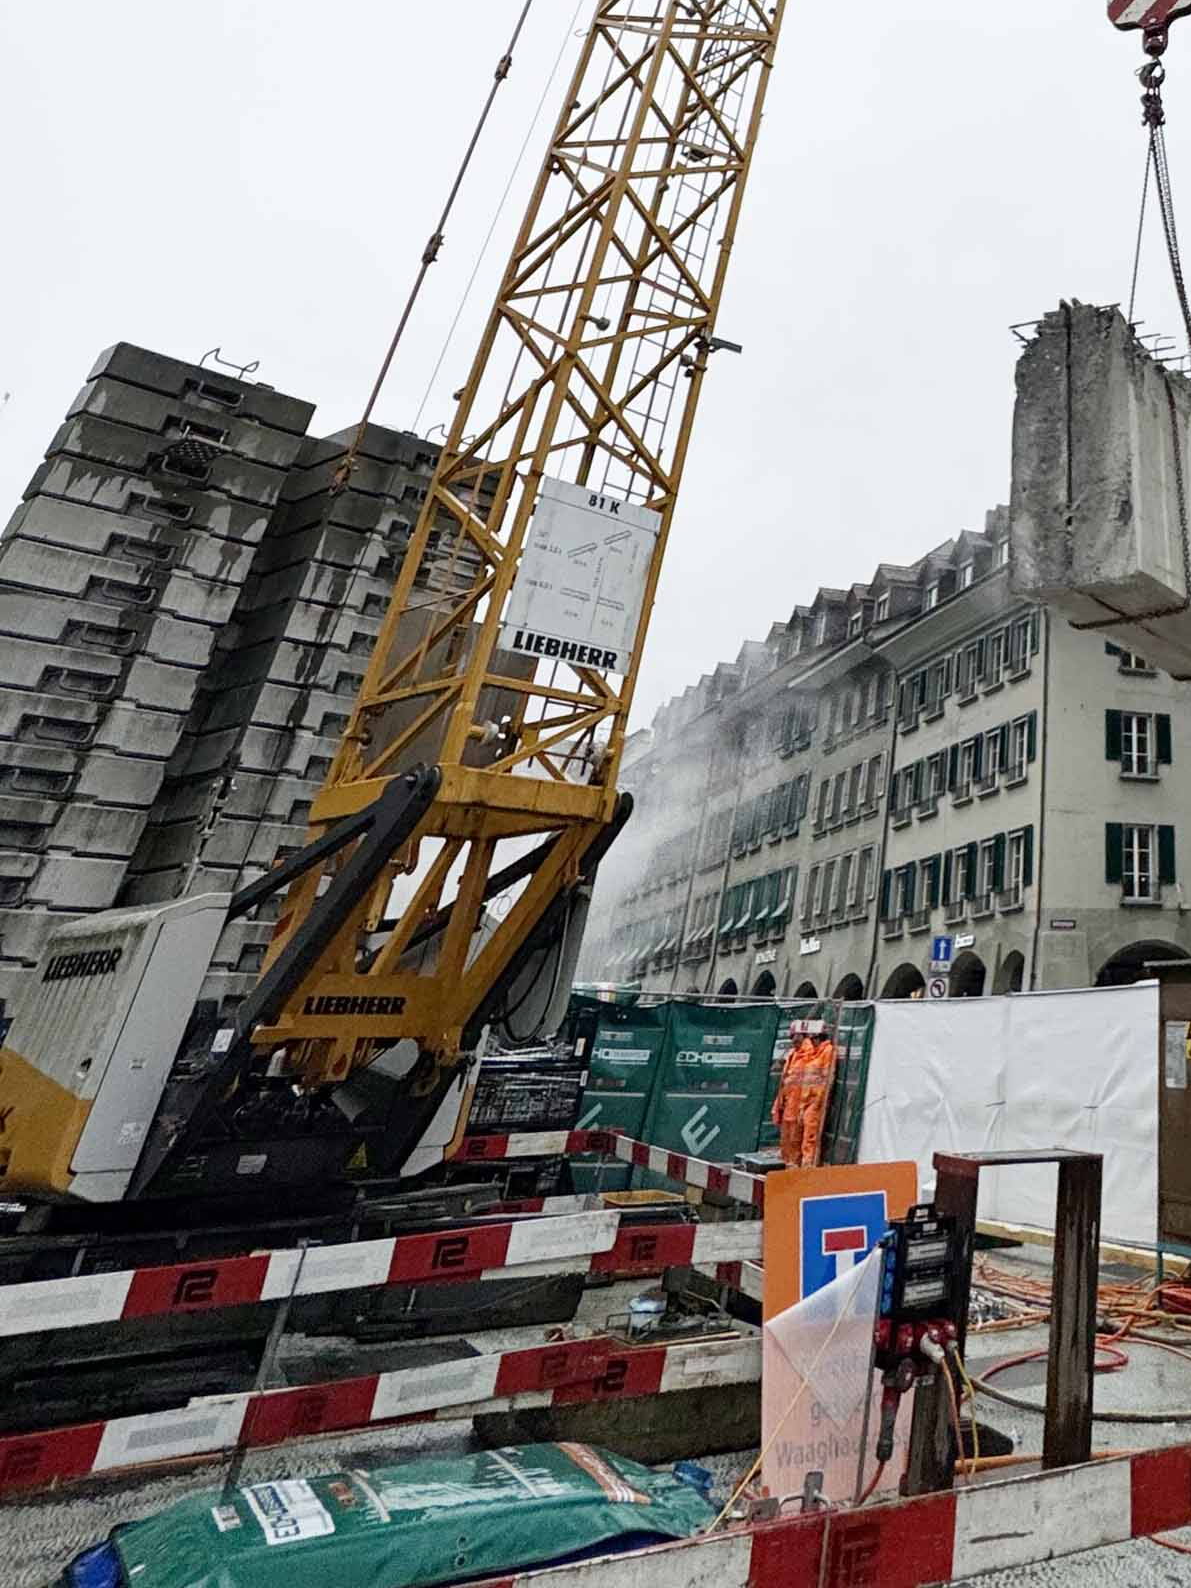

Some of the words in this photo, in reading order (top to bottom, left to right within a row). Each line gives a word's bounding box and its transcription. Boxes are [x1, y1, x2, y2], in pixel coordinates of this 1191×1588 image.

[588, 494, 605, 510] 81
[609, 501, 621, 514] K
[512, 630, 618, 670] LIEBHERR
[42, 948, 123, 983] LIEBHERR
[303, 996, 406, 1015] LIEBHERR
